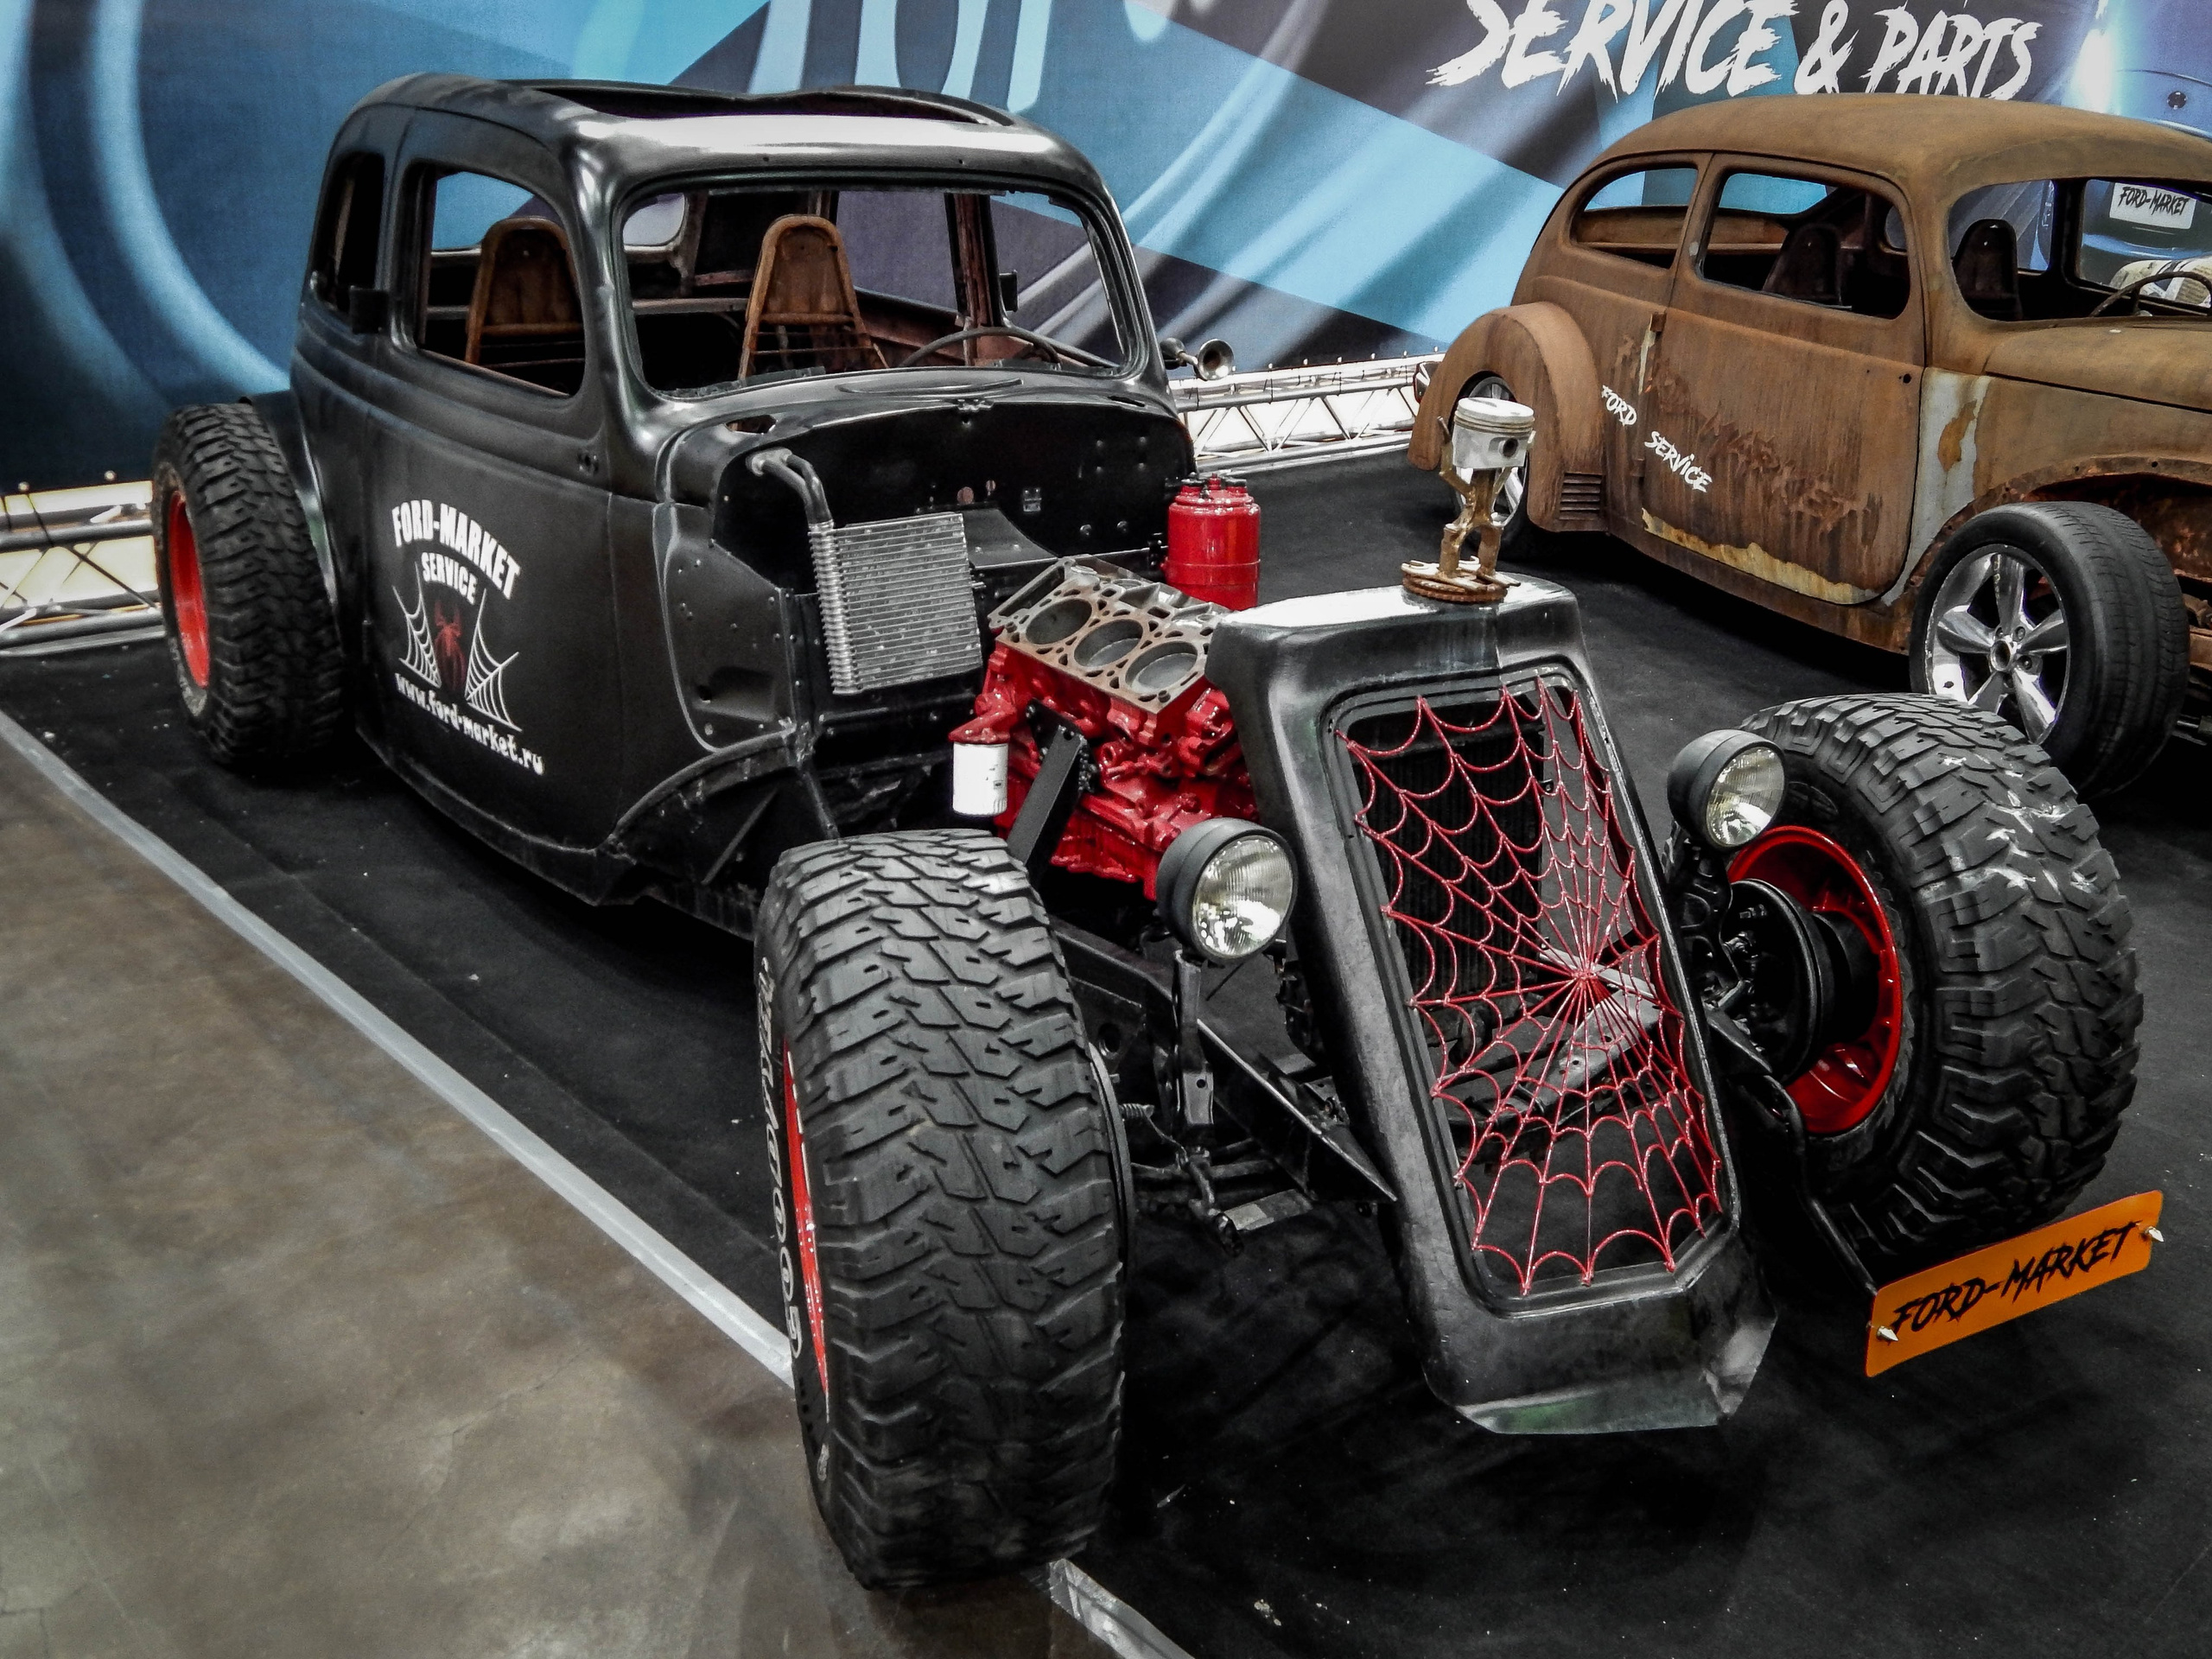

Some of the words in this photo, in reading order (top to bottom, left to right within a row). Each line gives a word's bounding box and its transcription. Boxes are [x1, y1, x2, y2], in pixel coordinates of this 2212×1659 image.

[1859, 3, 2043, 100] PARTS
[2118, 186, 2190, 216] FORD-MARKET
[1601, 385, 1637, 426] FORD
[391, 499, 521, 600] FORD-MARKET
[421, 552, 478, 605] SERVICE
[1889, 1220, 2143, 1338] FORD-MARKET
